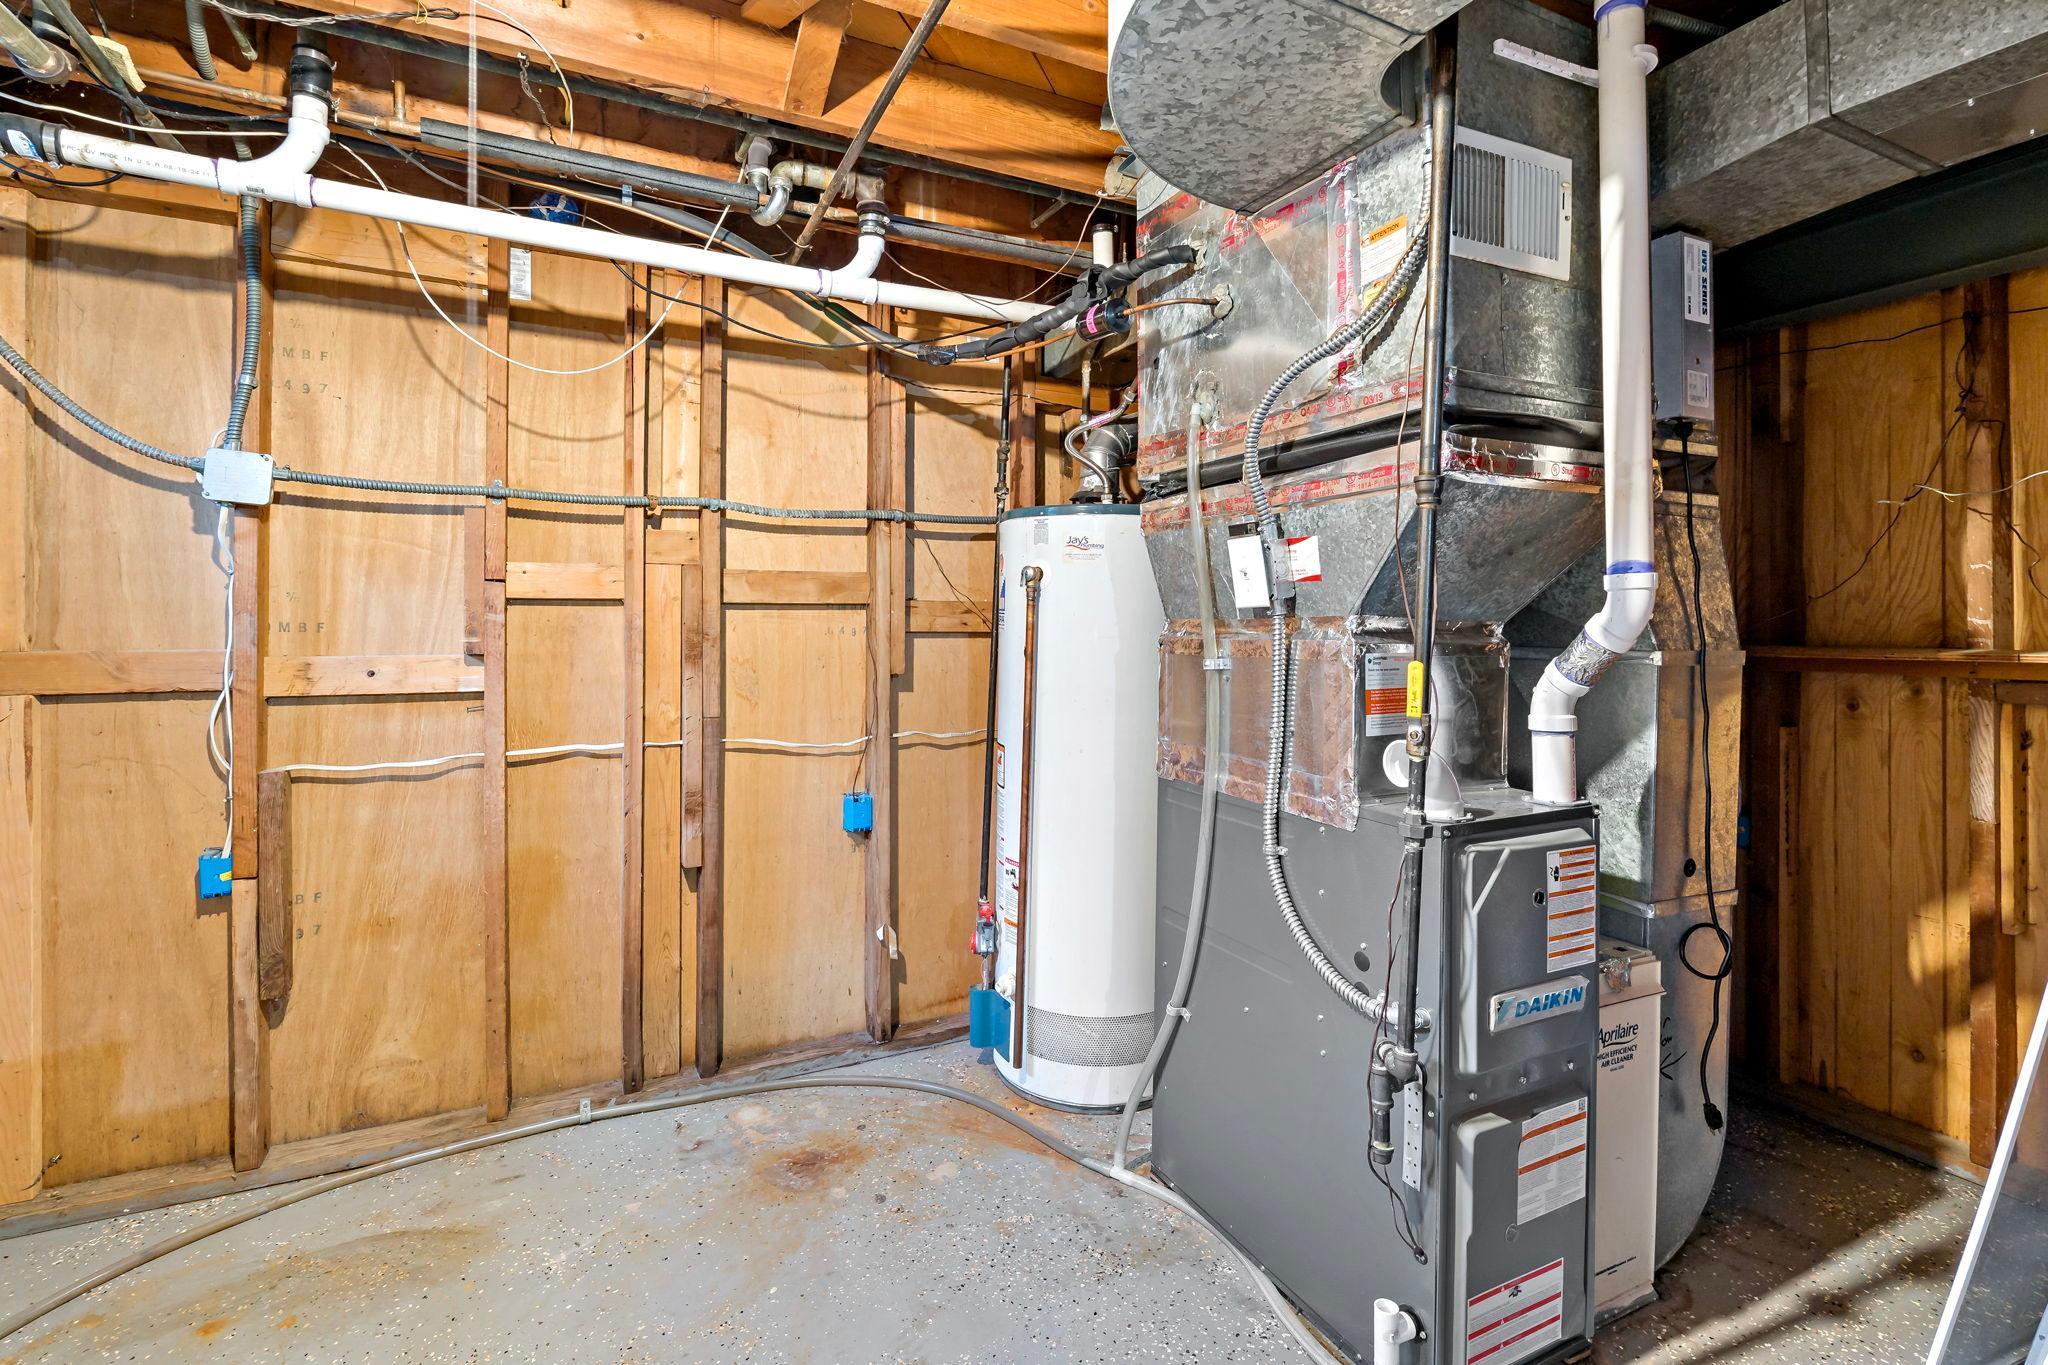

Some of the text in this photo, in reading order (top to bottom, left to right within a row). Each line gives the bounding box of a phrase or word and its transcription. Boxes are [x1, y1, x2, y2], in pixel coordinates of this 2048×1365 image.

[1370, 222, 1400, 241] ATTENTION
[1515, 986, 1584, 1017] DAIKIN
[1598, 1022, 1639, 1044] Aprilaire
[1610, 1044, 1638, 1058] EFFICIENCY
[1601, 1059, 1611, 1069] AIR
[1611, 1054, 1634, 1066] CLEANER
